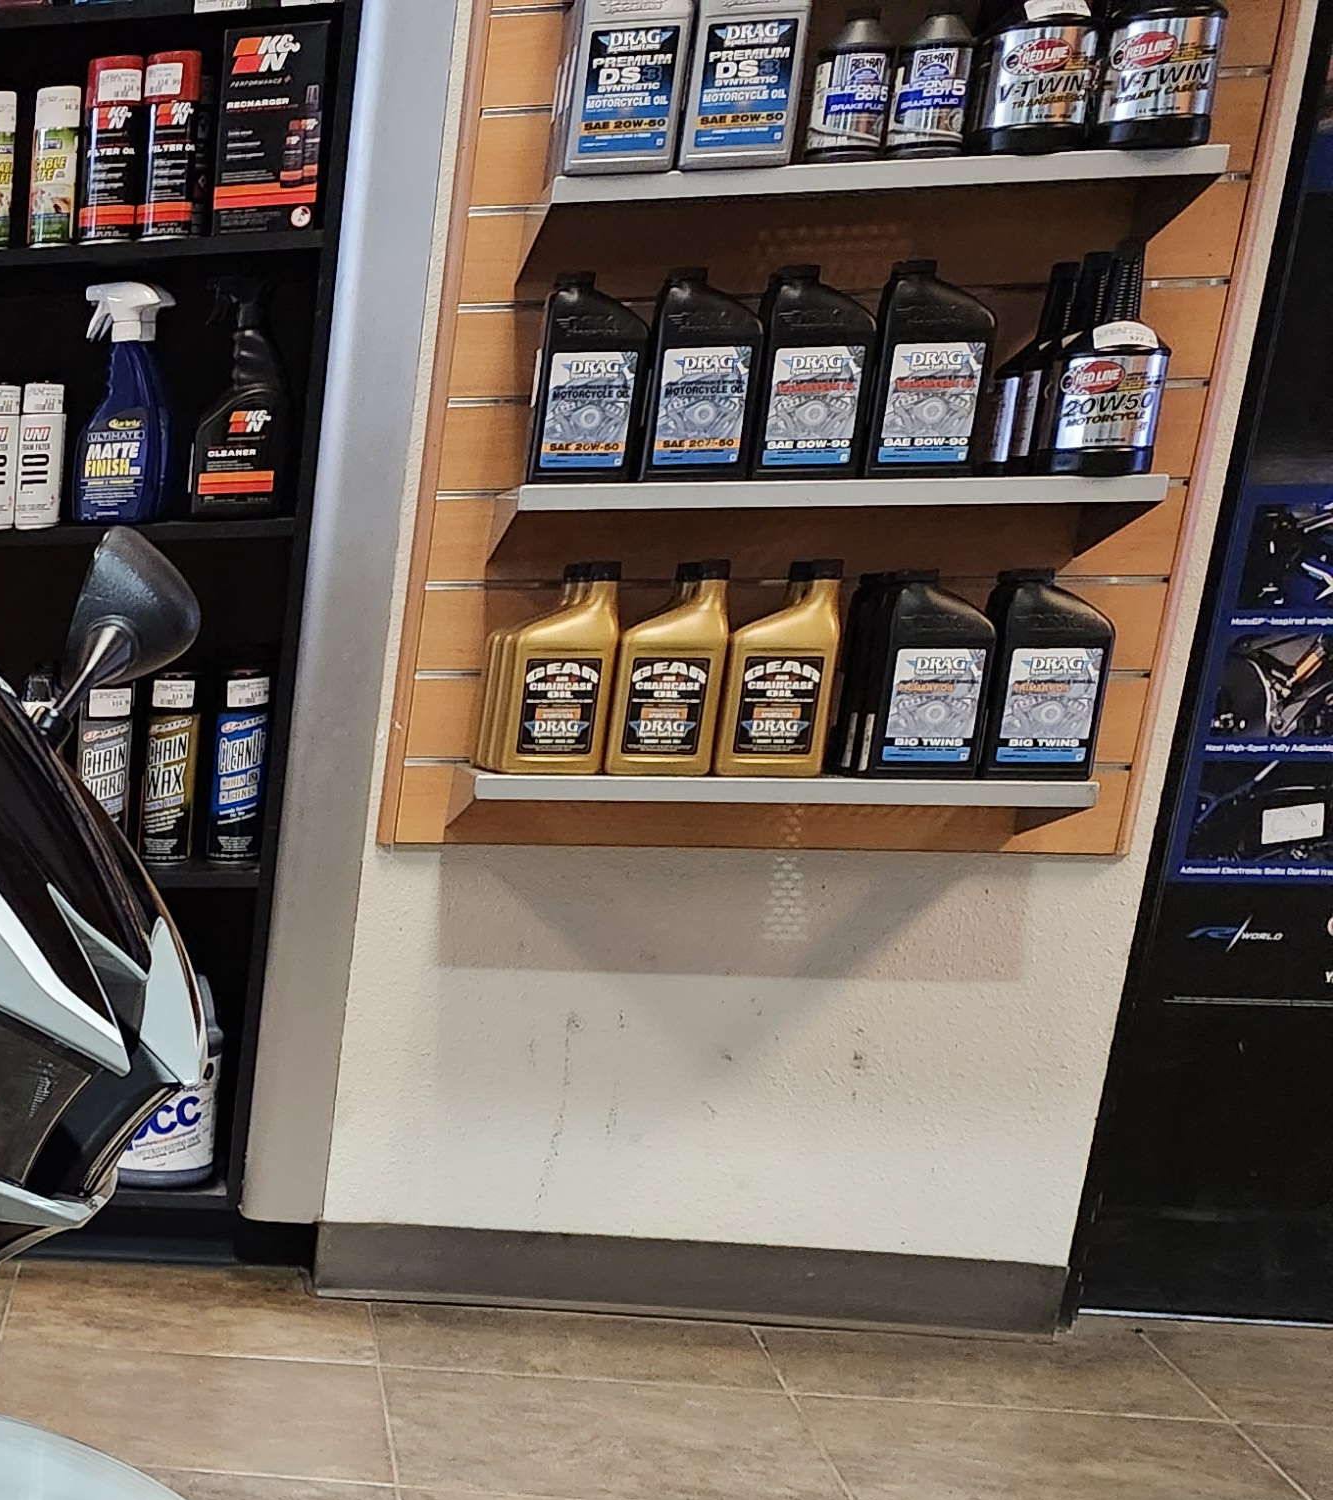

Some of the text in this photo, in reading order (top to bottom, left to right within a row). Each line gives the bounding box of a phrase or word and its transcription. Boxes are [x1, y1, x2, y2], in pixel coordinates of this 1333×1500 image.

[610, 29, 662, 48] DRAG
[727, 23, 779, 40] DRAG
[593, 53, 672, 69] PREMIUM
[709, 47, 790, 63] PREMIUM
[597, 81, 660, 93] SYNTHETIC
[714, 75, 778, 87] SYNTHETIC
[226, 97, 290, 110] RECHARGER
[586, 95, 669, 110] MOTORCYCLE OIL
[702, 88, 787, 104] MOTORCYCLE OIL
[584, 118, 666, 131] SAE 20W-50
[700, 112, 784, 126] SAE 20W-50
[683, 355, 733, 371] DRAG
[791, 355, 843, 370] DRAG
[910, 351, 963, 366] DRAG
[570, 359, 621, 375] DRAG
[551, 389, 614, 400] MOTORCYCLE
[664, 385, 727, 397] MOTORCYCLE
[1064, 393, 1153, 418] 20W50
[1065, 411, 1146, 428] MOTORCYCLE
[21, 426, 51, 442] UNI
[87, 430, 145, 443] ULTIMATE
[549, 442, 620, 452] SAE 20W-50
[766, 440, 793, 449] SAE
[882, 438, 910, 447] SAE
[86, 442, 140, 461] MATTE
[207, 448, 257, 458] CLEANER
[84, 458, 131, 478] FINISH
[915, 656, 966, 671] DRAG
[1031, 656, 1084, 671] DRAG
[525, 660, 599, 685] GEAR
[632, 660, 707, 685] GEAR
[528, 681, 593, 692] CHAINCASE
[634, 681, 701, 692] CHAINCASE
[747, 680, 815, 691] CHAINCASE
[546, 690, 574, 699] OIL
[653, 690, 681, 699] OIL
[765, 689, 794, 698] OIL
[533, 719, 579, 734] DRAG
[639, 719, 686, 734] DRAG
[751, 719, 799, 734] DRAG
[147, 732, 190, 766] CHAIN
[894, 737, 964, 747] BIG TWINS
[1008, 737, 1080, 748] BIG TWINS
[82, 742, 128, 777] CHAIN
[146, 763, 187, 801] WAX
[1241, 931, 1284, 942] WORLD
